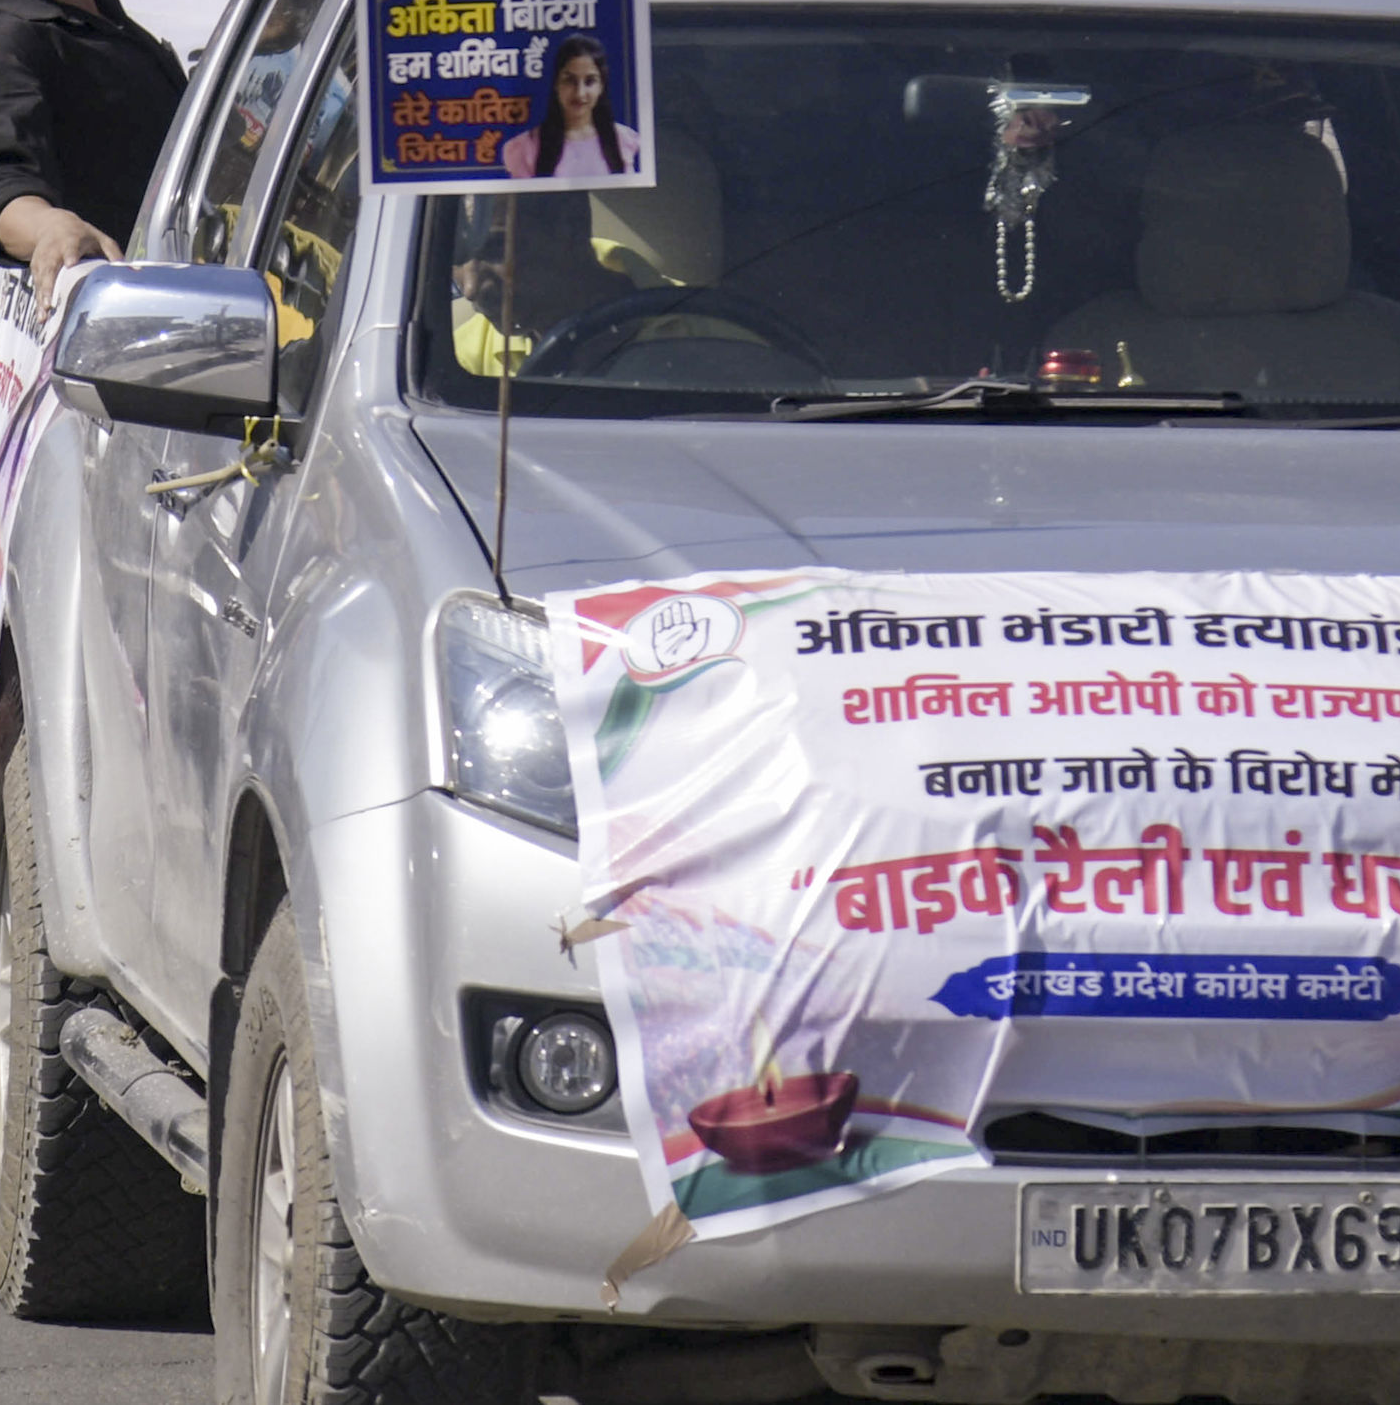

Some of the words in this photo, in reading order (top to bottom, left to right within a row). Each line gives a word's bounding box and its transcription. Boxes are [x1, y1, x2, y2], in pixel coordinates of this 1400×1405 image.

[387, 52, 432, 83] हम
[524, 36, 549, 78] हैं
[392, 91, 432, 126] तेरे
[436, 88, 530, 125] कातिल
[397, 132, 467, 163] जिंदा
[795, 610, 984, 655] अंकिता
[1003, 606, 1174, 649] भंडारी
[842, 674, 1013, 726] शामिल
[1028, 670, 1182, 716] आरोपी
[1195, 673, 1259, 717] को
[919, 757, 1044, 798] बनाए
[1054, 748, 1158, 793] जाने
[1172, 748, 1215, 792] के
[1228, 750, 1357, 799] विरोध
[1033, 824, 1192, 917] रैली
[1202, 829, 1311, 918] एवं
[1112, 960, 1188, 1000] प्रदेश
[1193, 962, 1291, 1001] कांग्रेस
[1296, 963, 1384, 1002] कमेटी
[1031, 1230, 1067, 1248] IND
